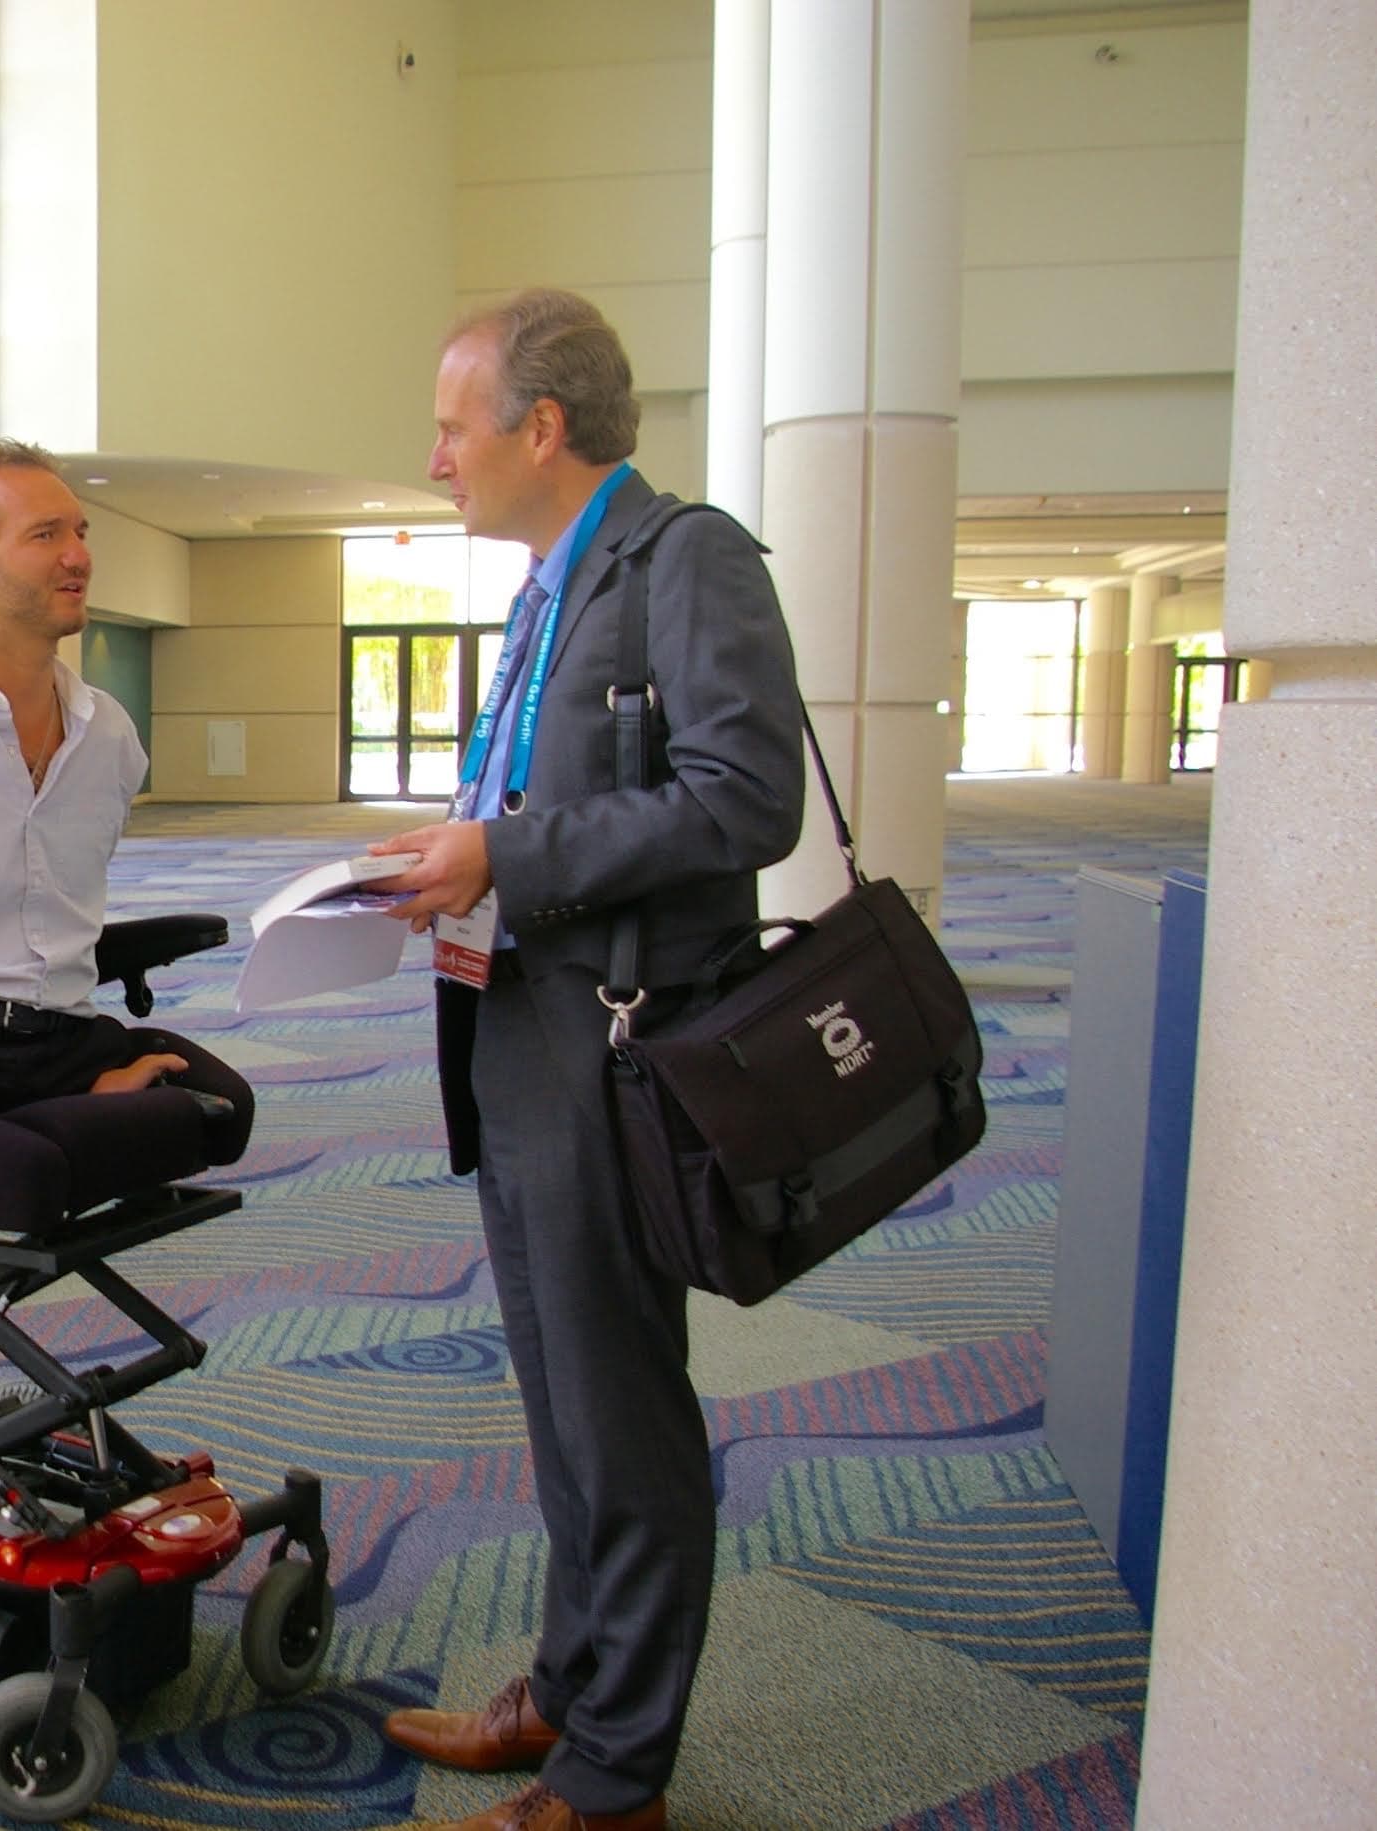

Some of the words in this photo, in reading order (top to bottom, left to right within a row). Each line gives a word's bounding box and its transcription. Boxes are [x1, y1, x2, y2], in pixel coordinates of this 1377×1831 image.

[527, 684, 540, 702] Go
[476, 718, 491, 738] Get
[519, 706, 536, 745] Forth!
